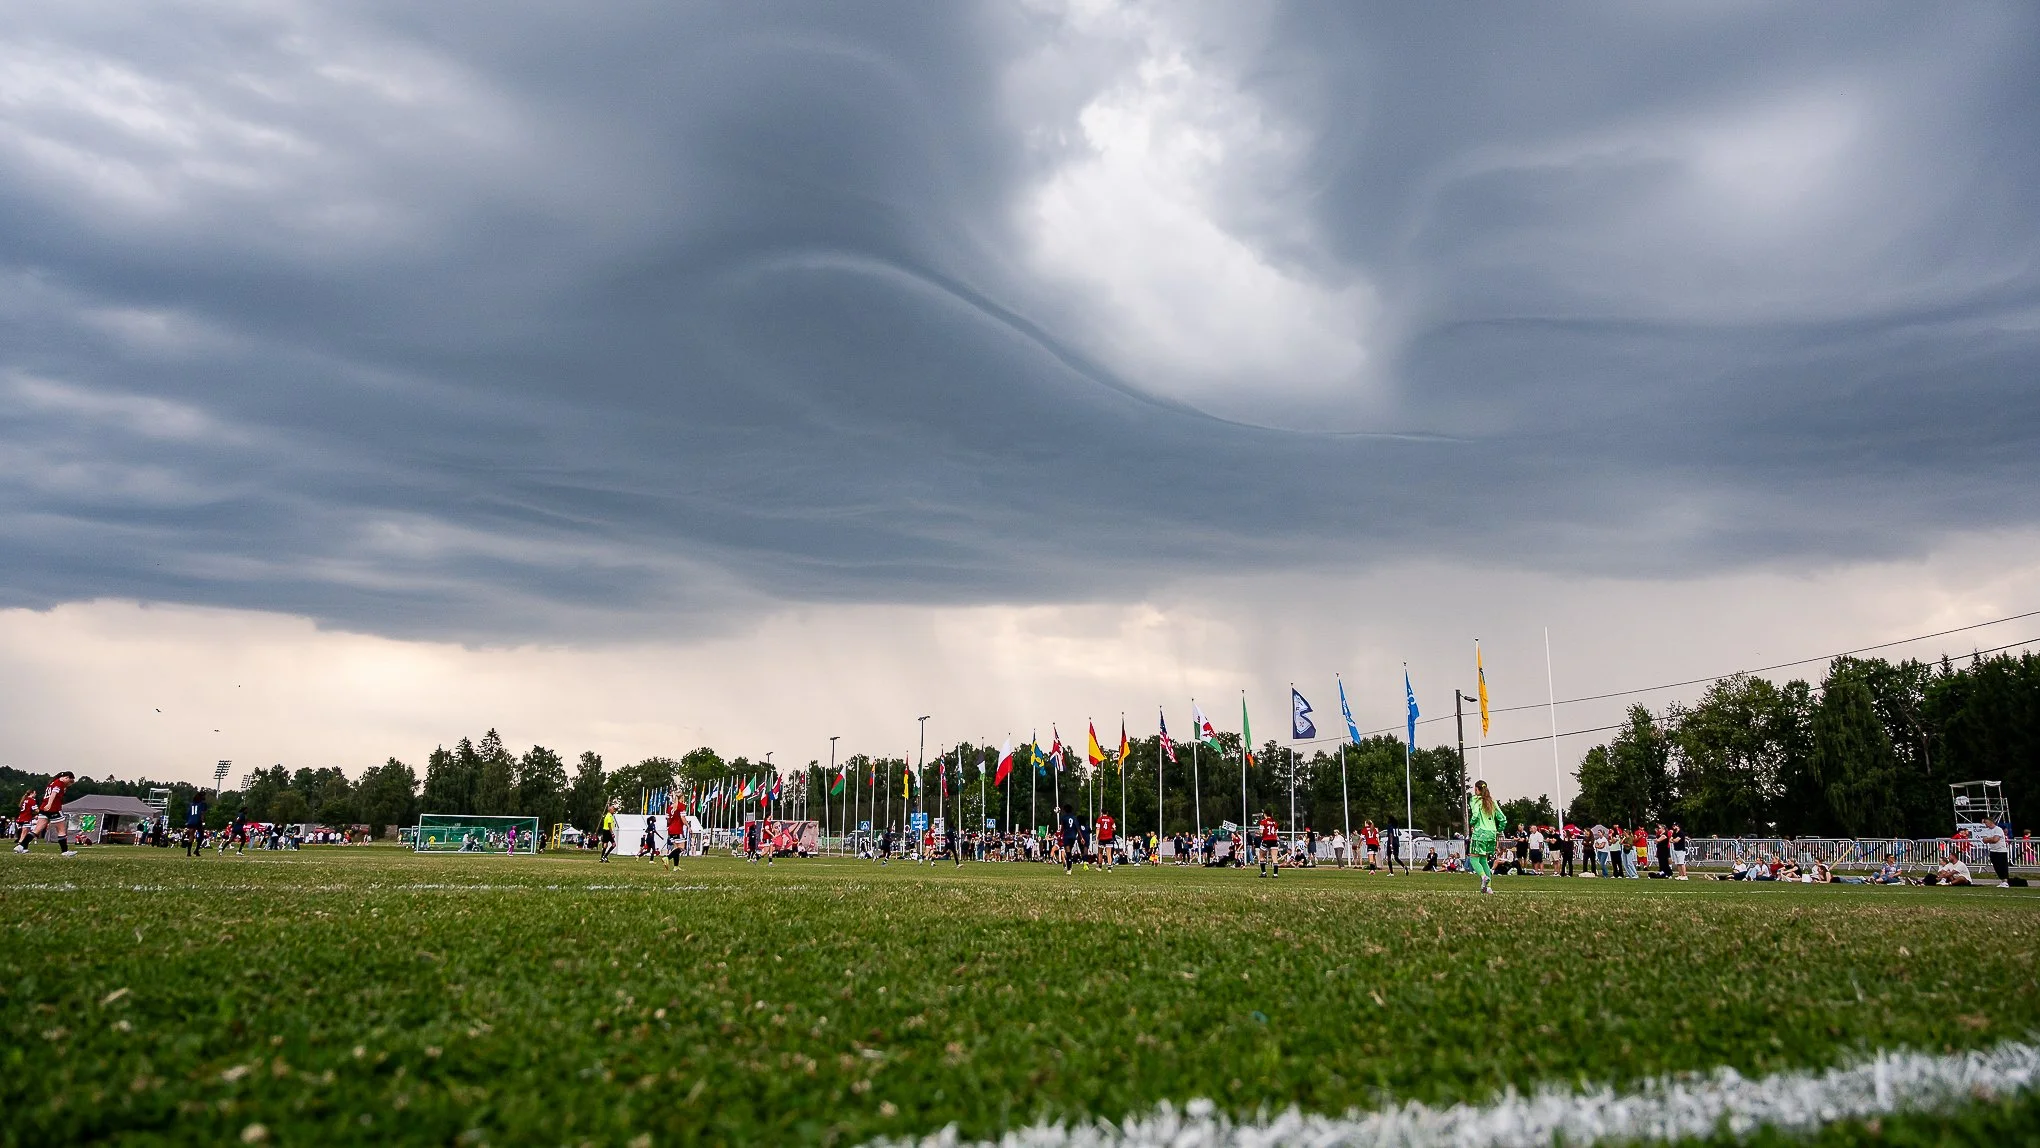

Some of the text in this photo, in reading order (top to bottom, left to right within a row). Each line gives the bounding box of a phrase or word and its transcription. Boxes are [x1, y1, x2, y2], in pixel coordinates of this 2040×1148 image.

[191, 805, 198, 816] 11
[1068, 817, 1074, 828] 9
[1266, 825, 1275, 836] 14
